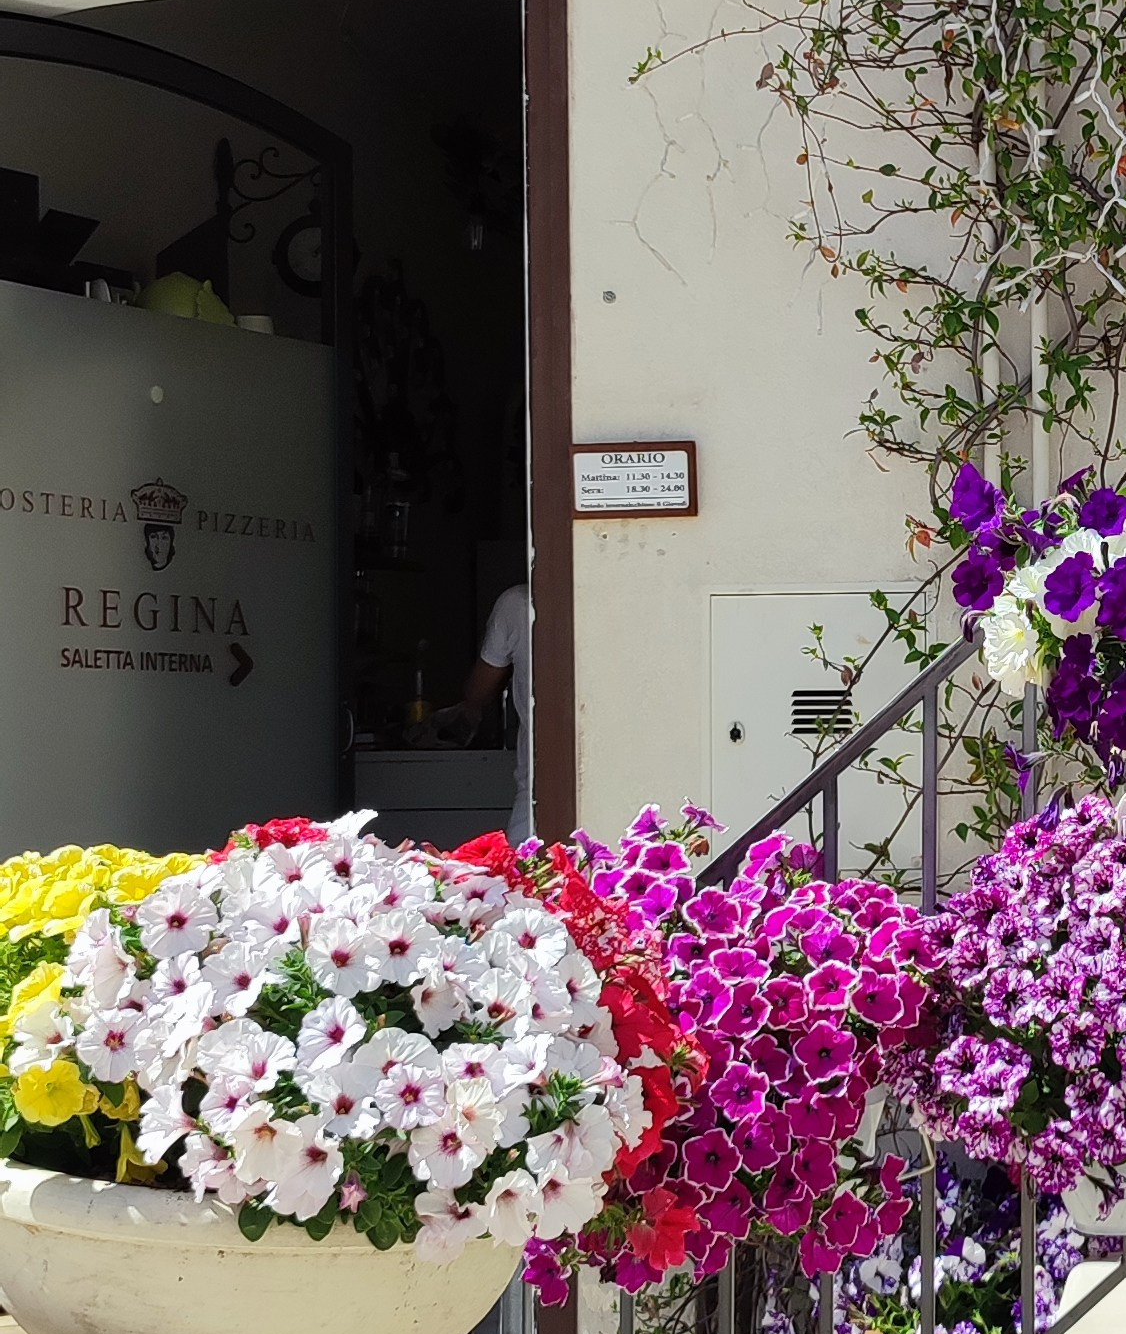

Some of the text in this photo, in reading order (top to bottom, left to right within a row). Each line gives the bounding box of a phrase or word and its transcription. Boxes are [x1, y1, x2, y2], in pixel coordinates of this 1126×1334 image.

[601, 453, 665, 464] ORARIO
[626, 473, 651, 481] 11.30
[660, 472, 685, 481] 14.30
[0, 487, 316, 543] OSTERIA PIZZERIA
[61, 586, 251, 636] REGINA
[61, 647, 214, 674] SALETTA INTERNA
